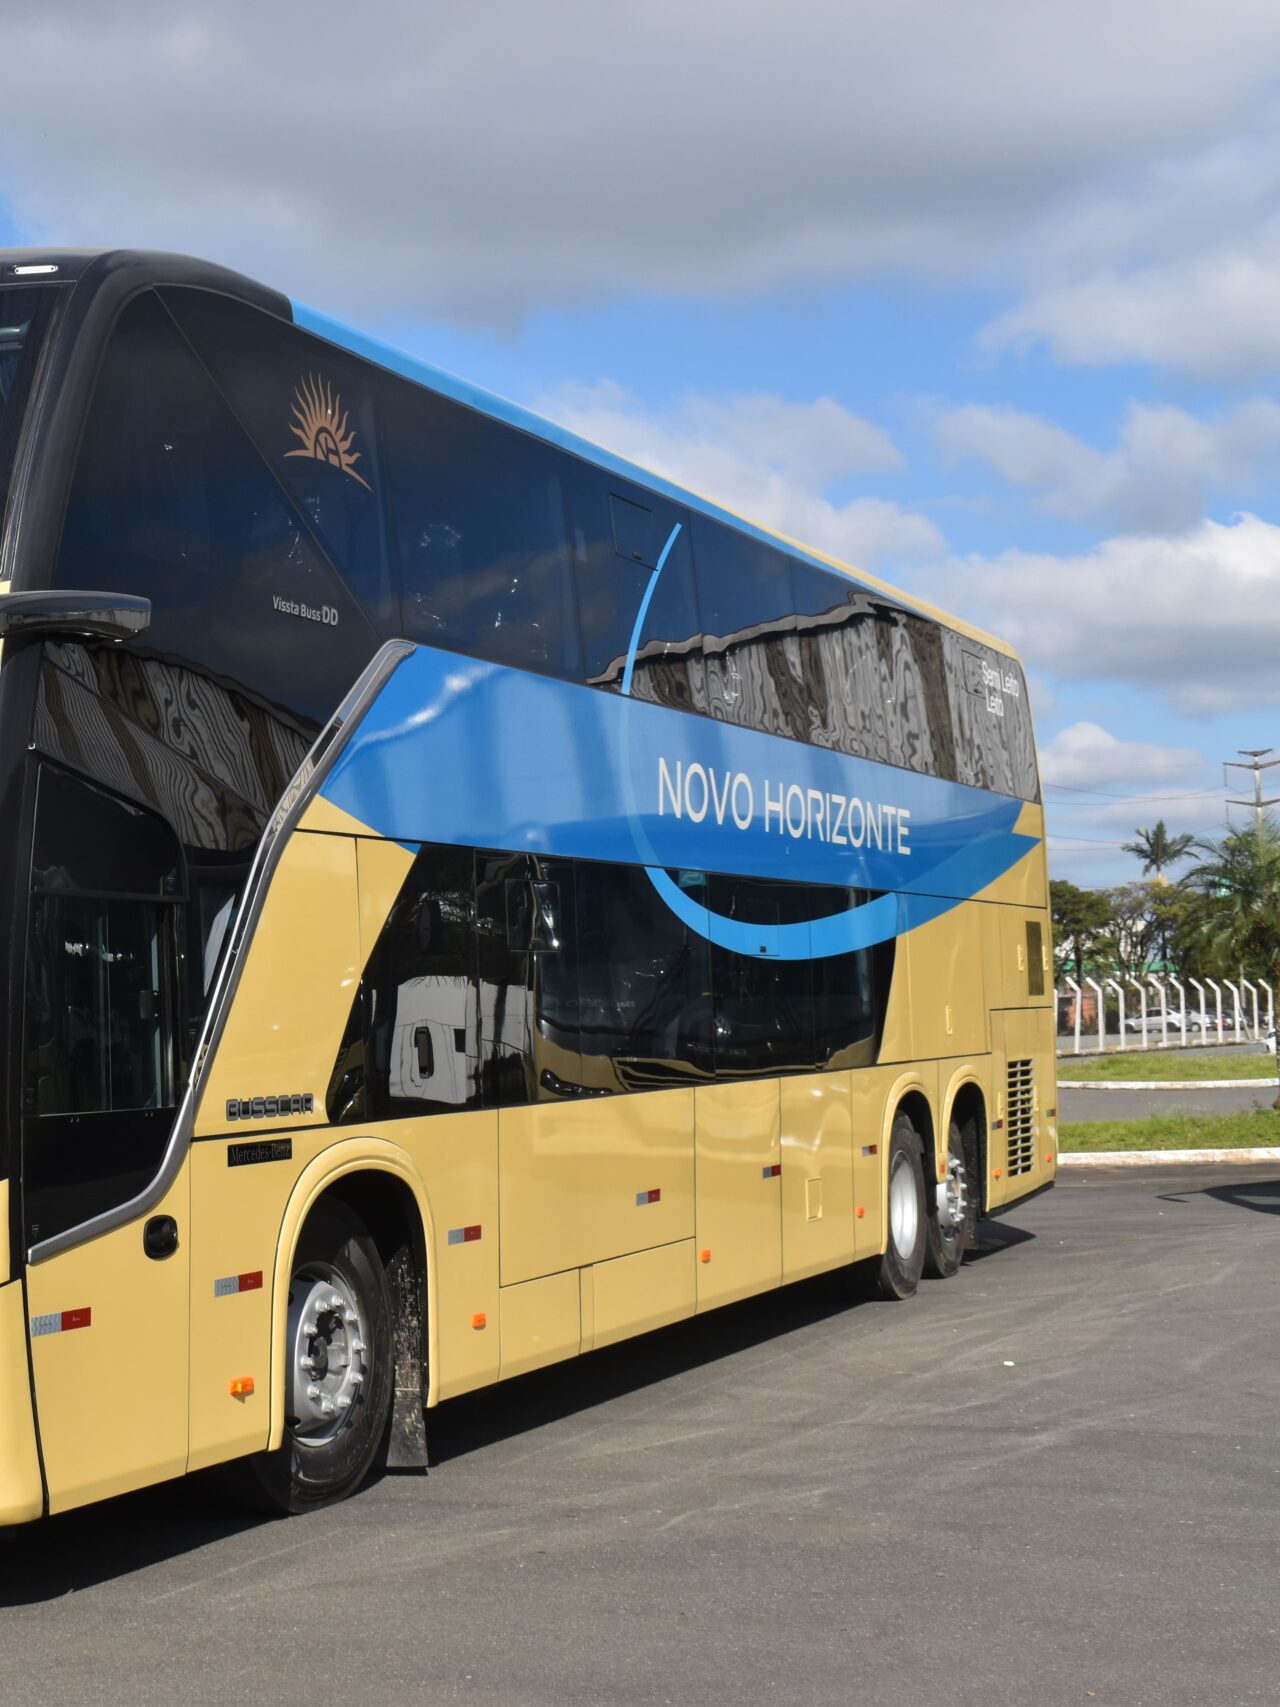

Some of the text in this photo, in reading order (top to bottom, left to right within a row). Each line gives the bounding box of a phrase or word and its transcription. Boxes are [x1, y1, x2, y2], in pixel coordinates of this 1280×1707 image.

[272, 594, 339, 626] Vissta Buss DD
[658, 756, 912, 856] NOVO HORIZONTE
[226, 1093, 314, 1121] BUSSCAR
[230, 1142, 291, 1164] Mercedes-Benz
